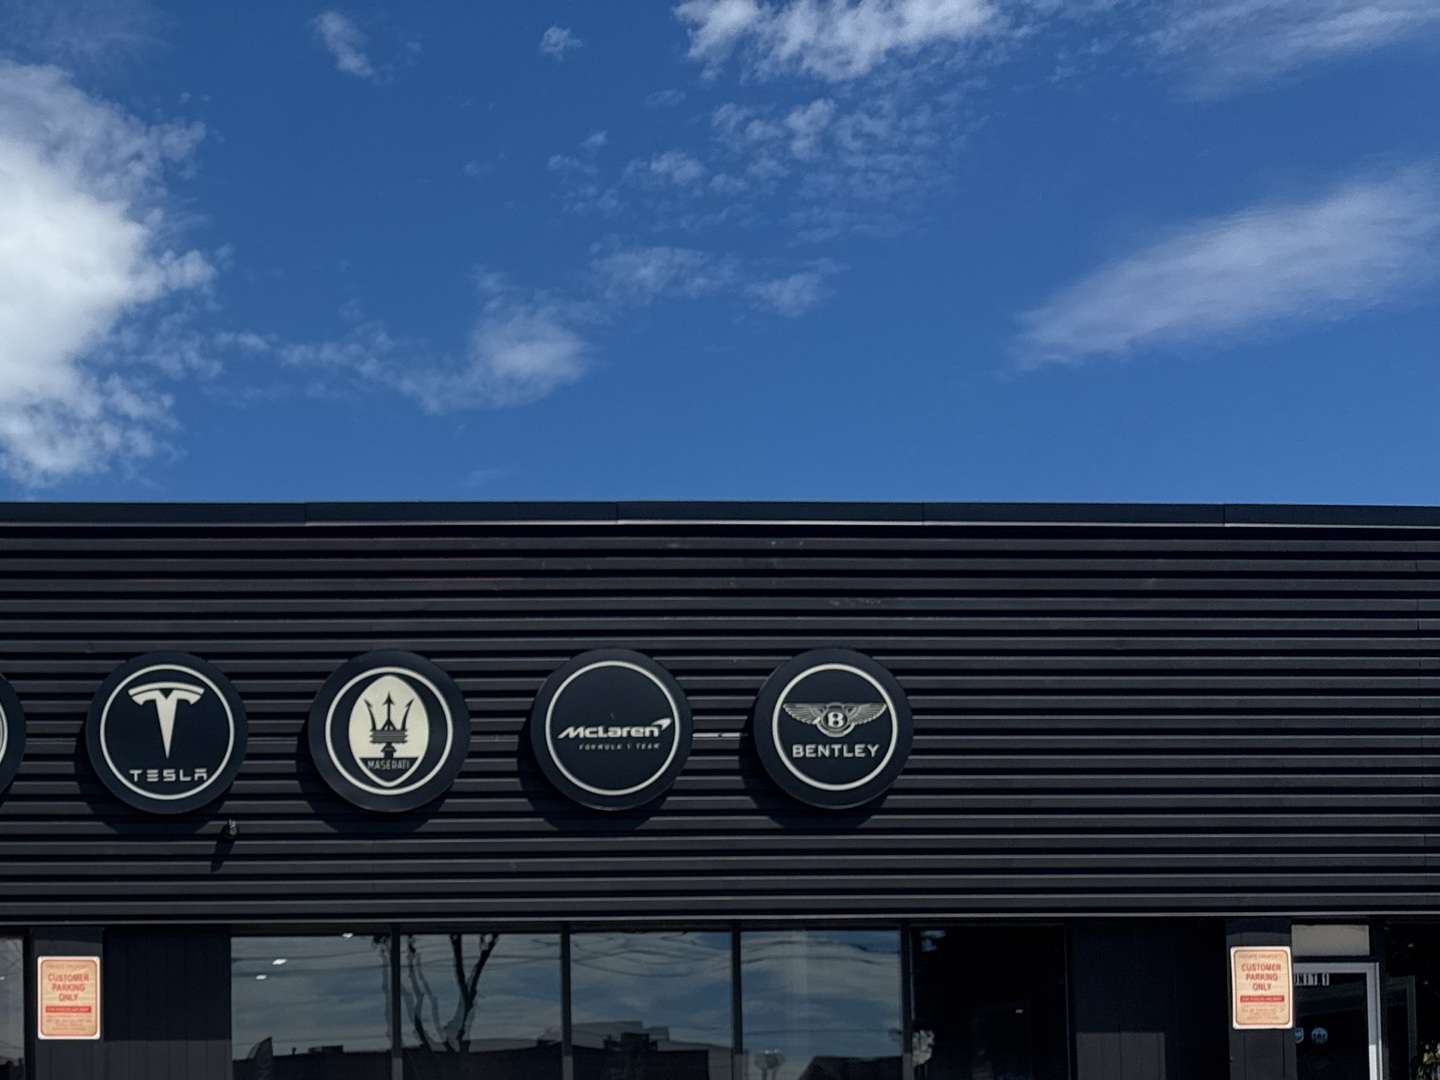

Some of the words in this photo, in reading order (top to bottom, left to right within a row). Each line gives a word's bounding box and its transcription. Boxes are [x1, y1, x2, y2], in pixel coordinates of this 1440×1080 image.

[557, 725, 659, 739] McLaren
[792, 744, 879, 758] BENTLEY
[367, 759, 411, 771] MASERATI
[129, 768, 209, 782] TESLA
[1241, 963, 1282, 972] CUSTOMER
[47, 973, 89, 982] CUSTOMER
[1246, 973, 1279, 981] PARKING
[51, 983, 86, 992] PARKING
[1252, 982, 1272, 992] ONLY
[58, 993, 79, 1002] ONLY
